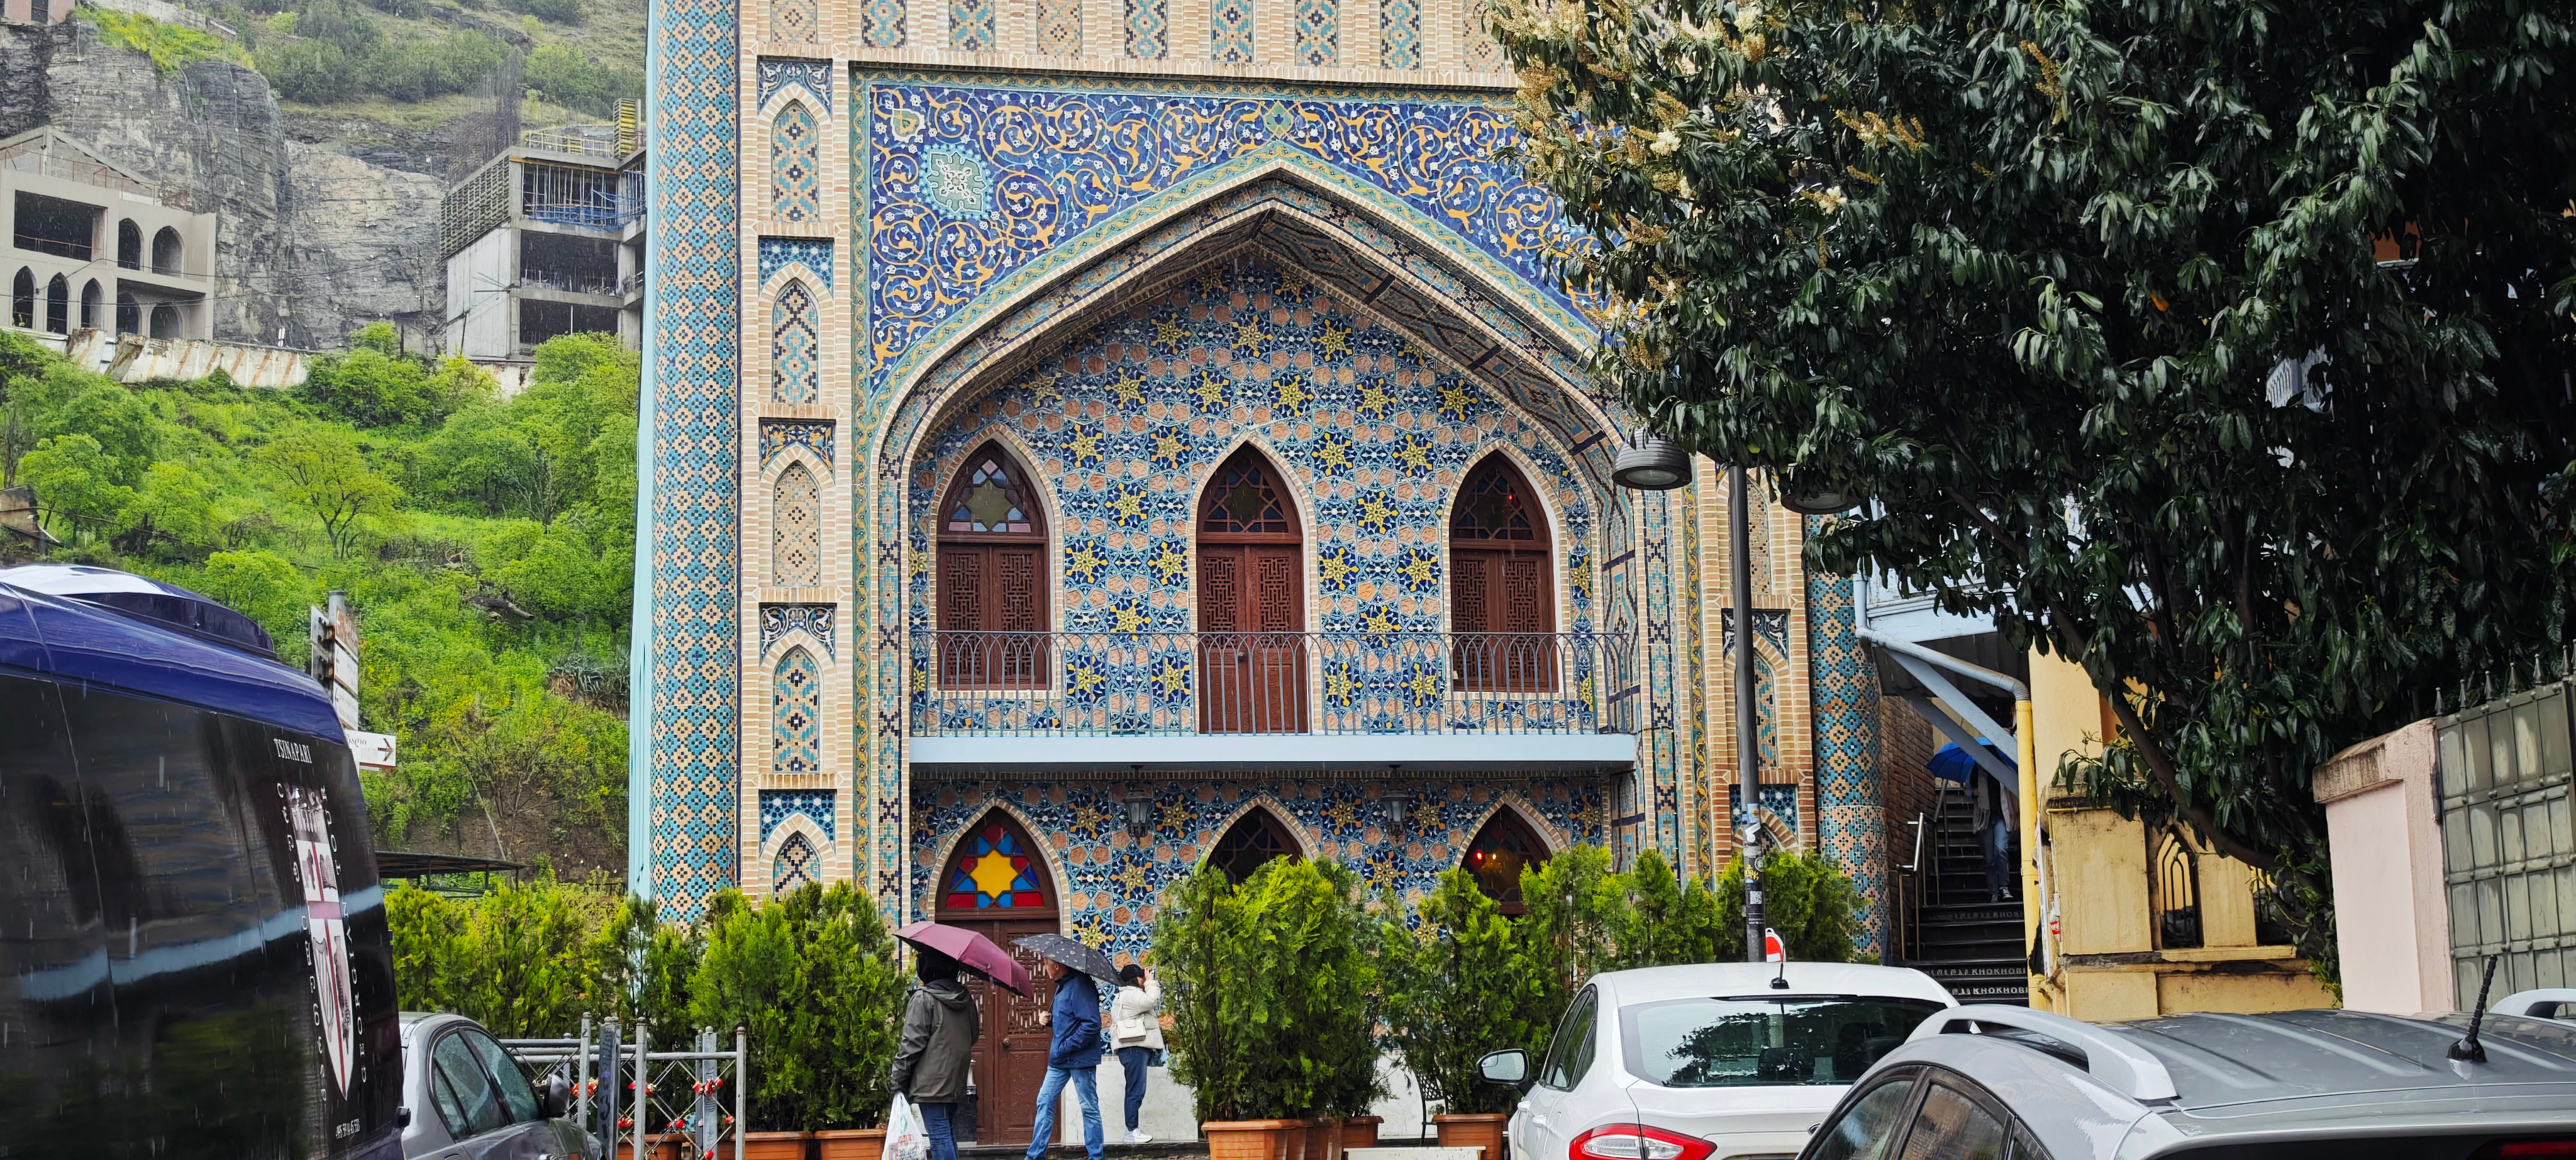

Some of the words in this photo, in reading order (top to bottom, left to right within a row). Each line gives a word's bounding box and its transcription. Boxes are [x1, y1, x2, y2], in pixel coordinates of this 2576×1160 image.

[273, 738, 313, 764] TSINAPARI
[321, 784, 341, 876] TOUR
[1972, 967, 2026, 975] KHOKHOBI
[342, 901, 367, 1083] GEORGIAN
[1973, 986, 2028, 995] KHOKHOBI
